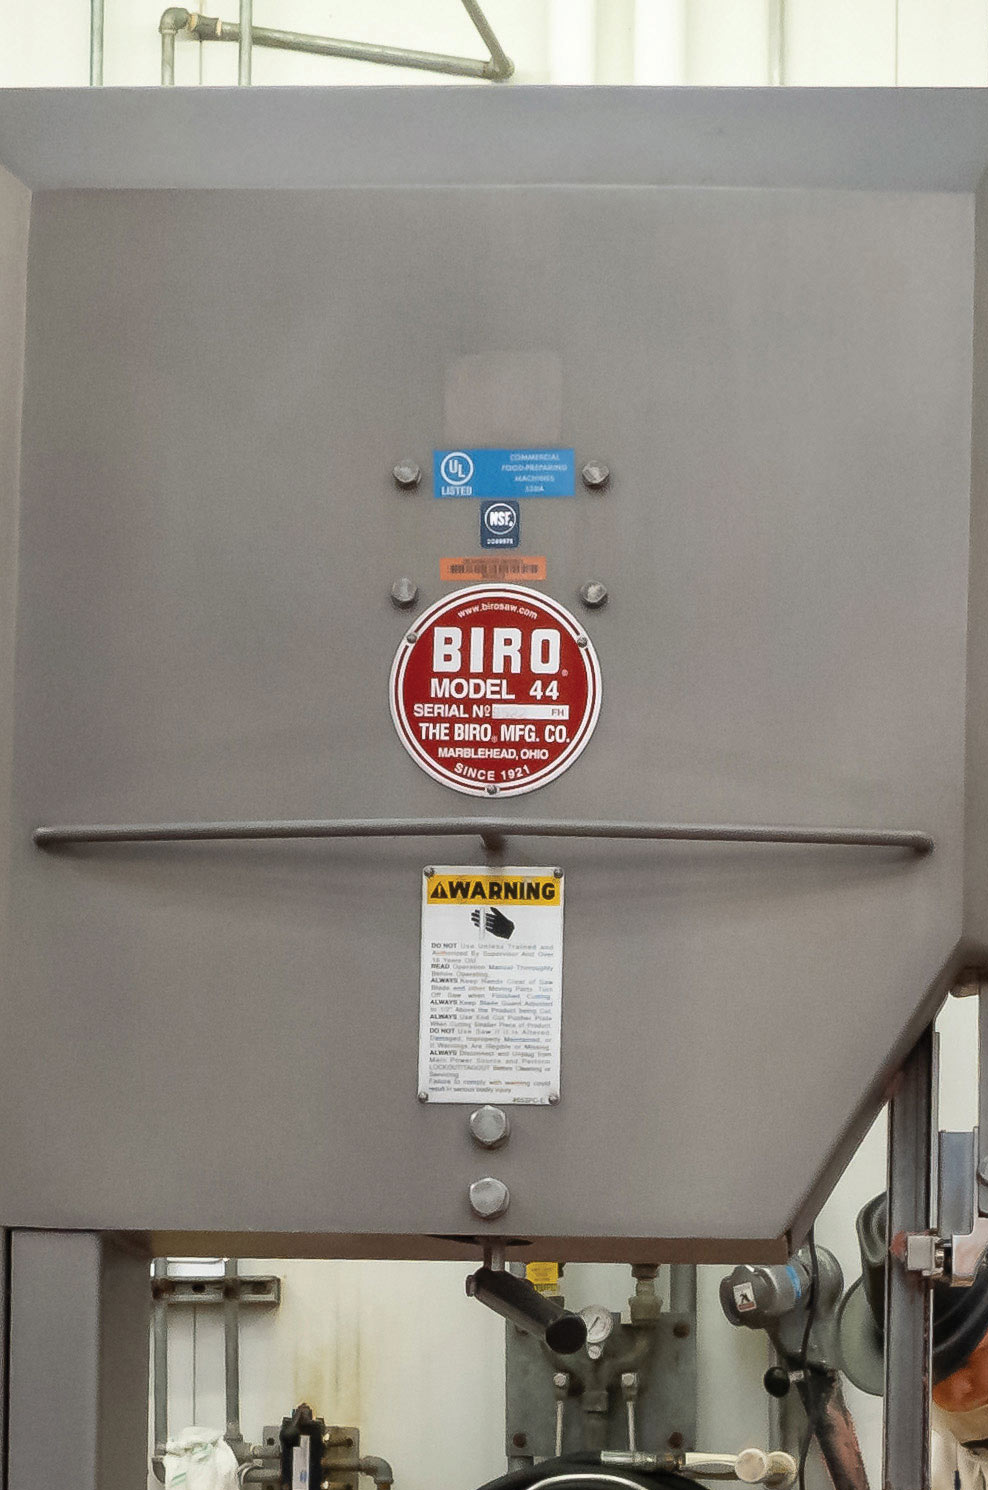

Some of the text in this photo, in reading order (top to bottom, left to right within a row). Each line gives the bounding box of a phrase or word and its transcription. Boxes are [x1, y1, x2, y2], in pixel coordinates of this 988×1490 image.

[449, 460, 465, 477] UL
[441, 486, 472, 496] LISTED
[457, 603, 538, 620] www.birosaw.com
[433, 627, 561, 674] BIRO
[430, 679, 559, 700] MODEL 44
[414, 704, 469, 718] SERIAL
[419, 723, 450, 740] THE
[501, 725, 539, 742] MFG.
[545, 725, 570, 743] CO.
[438, 748, 548, 759] MARBLEHEAD, OHIO
[454, 763, 530, 780] SINCE 1921
[448, 881, 555, 900] WARNING
